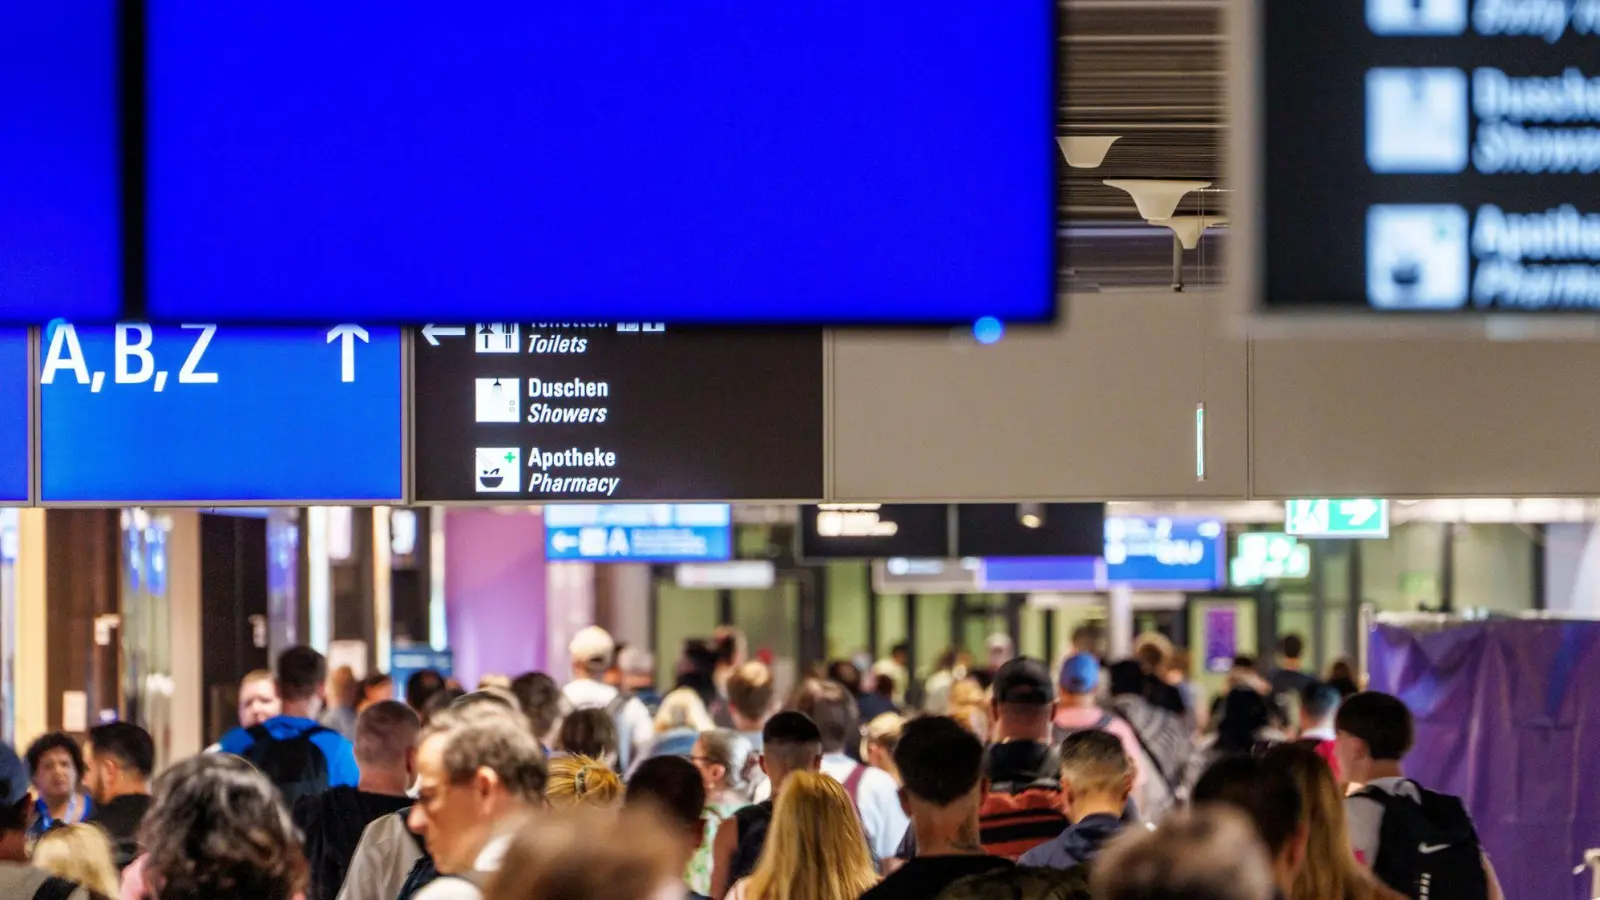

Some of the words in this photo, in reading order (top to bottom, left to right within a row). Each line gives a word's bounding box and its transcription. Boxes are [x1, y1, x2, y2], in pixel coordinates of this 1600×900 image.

[527, 334, 588, 354] Toilets
[528, 377, 609, 398] Duschen
[527, 403, 608, 423] Showers
[527, 447, 616, 471] Apotheke
[528, 472, 620, 497] Pharmacy
